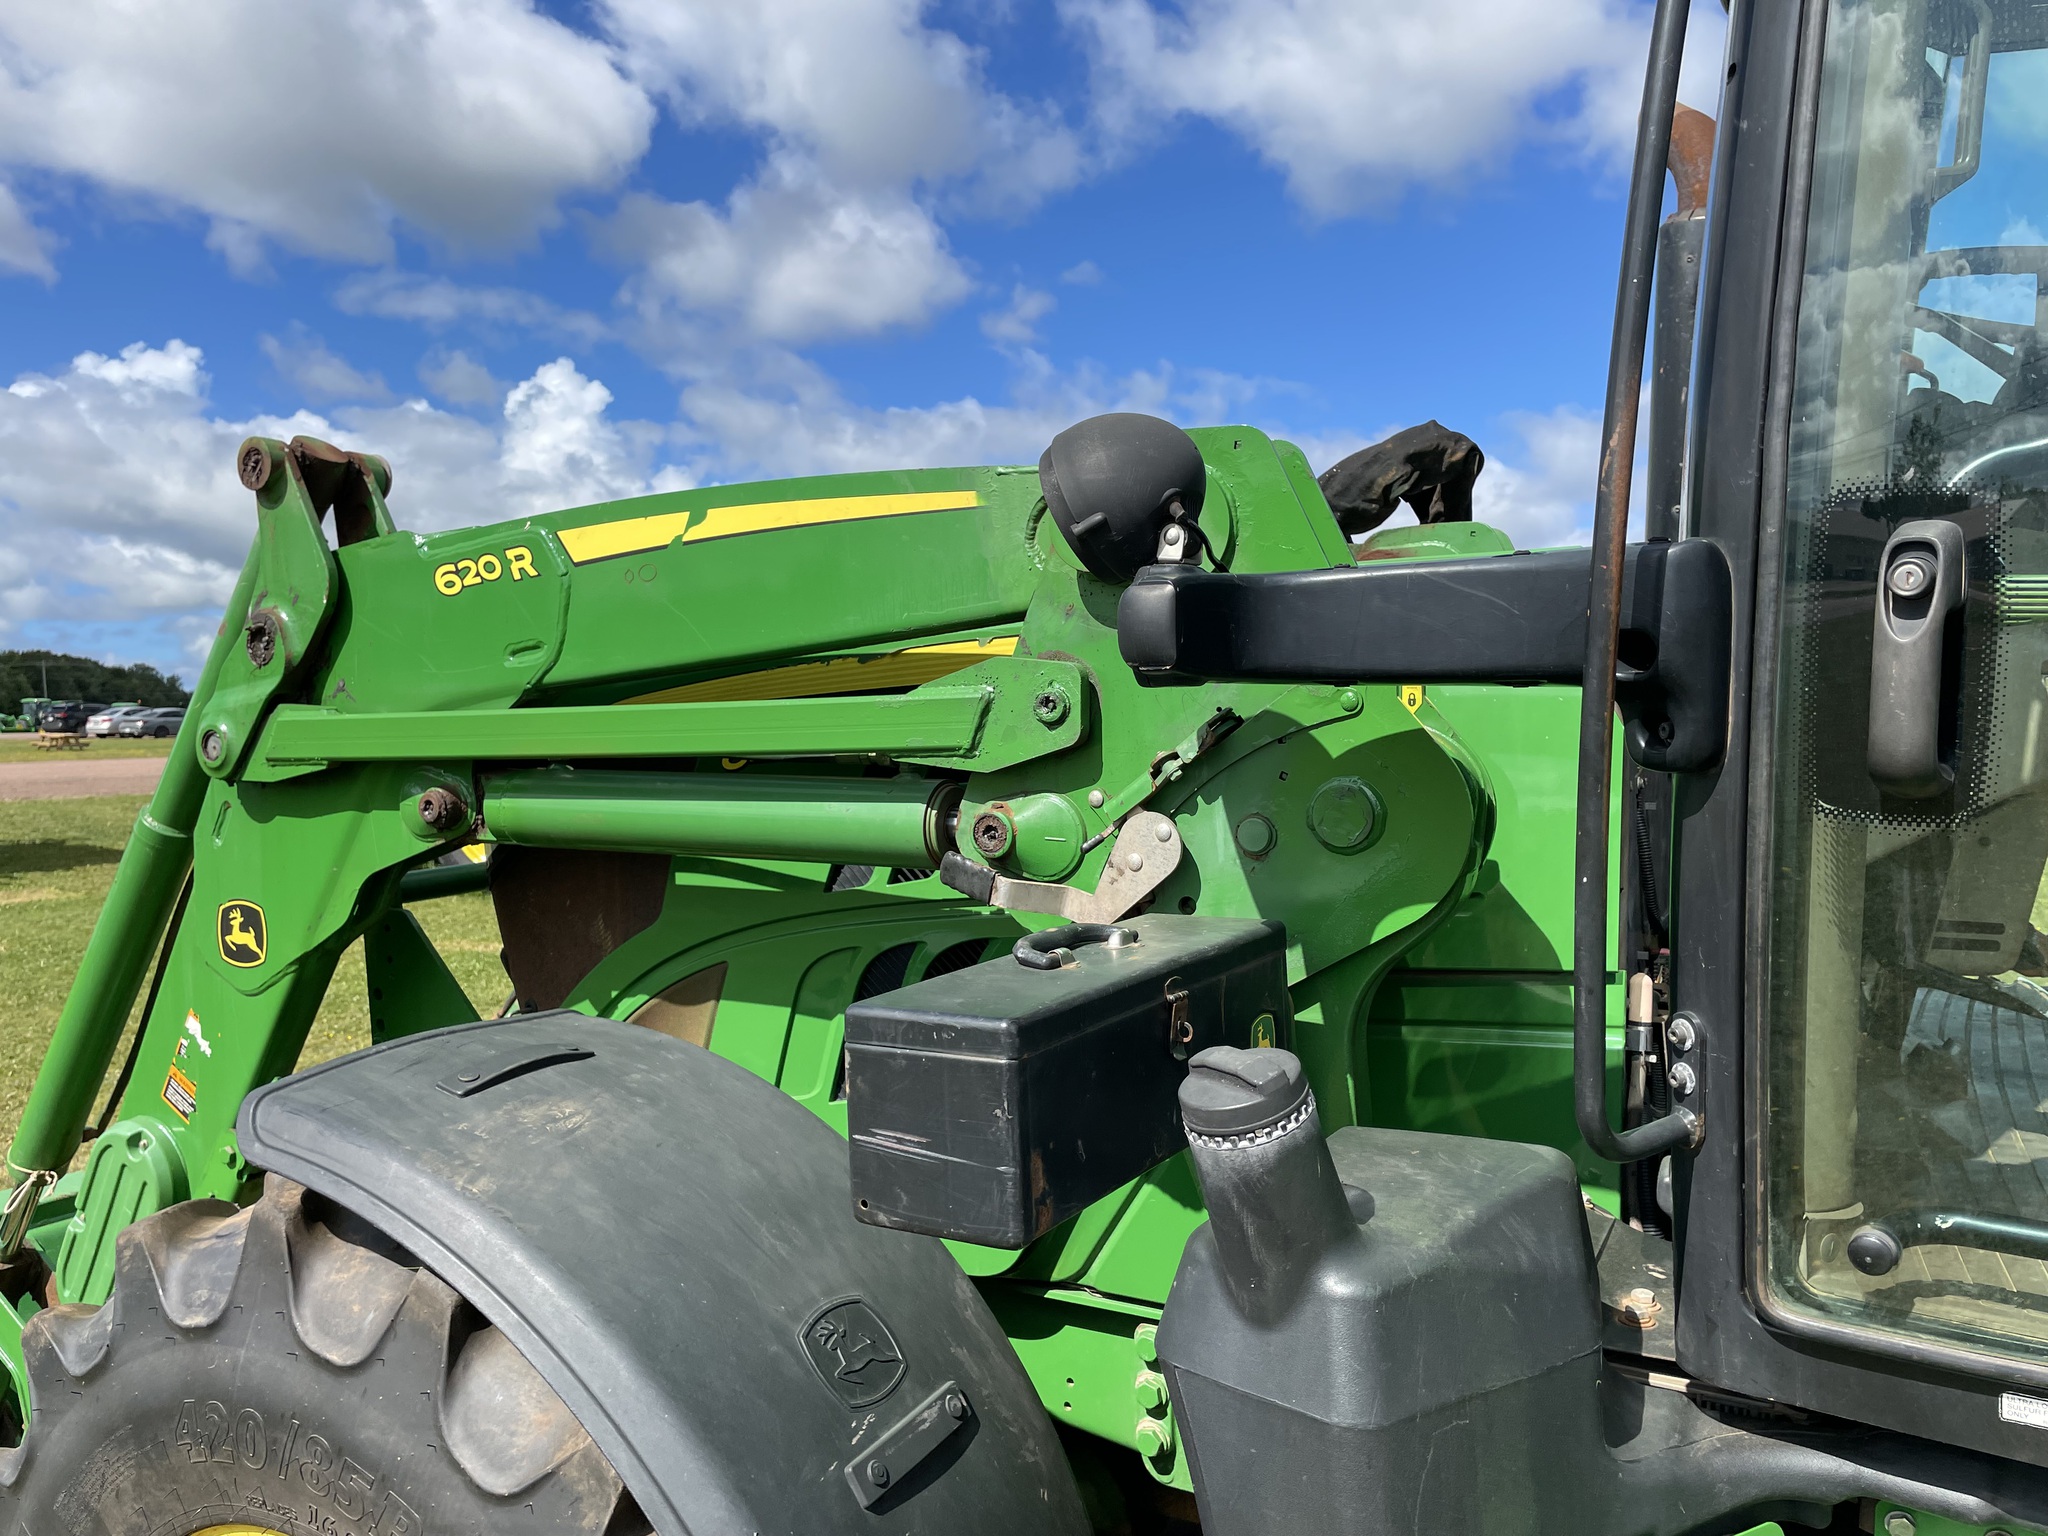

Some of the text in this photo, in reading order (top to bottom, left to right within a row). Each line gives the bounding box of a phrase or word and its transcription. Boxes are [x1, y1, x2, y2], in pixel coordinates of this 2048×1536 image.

[433, 545, 541, 596] 620 R
[2006, 1395, 2034, 1407] ULTRA
[2006, 1403, 2042, 1416] SULFUR
[2006, 1409, 2029, 1419] ONLY
